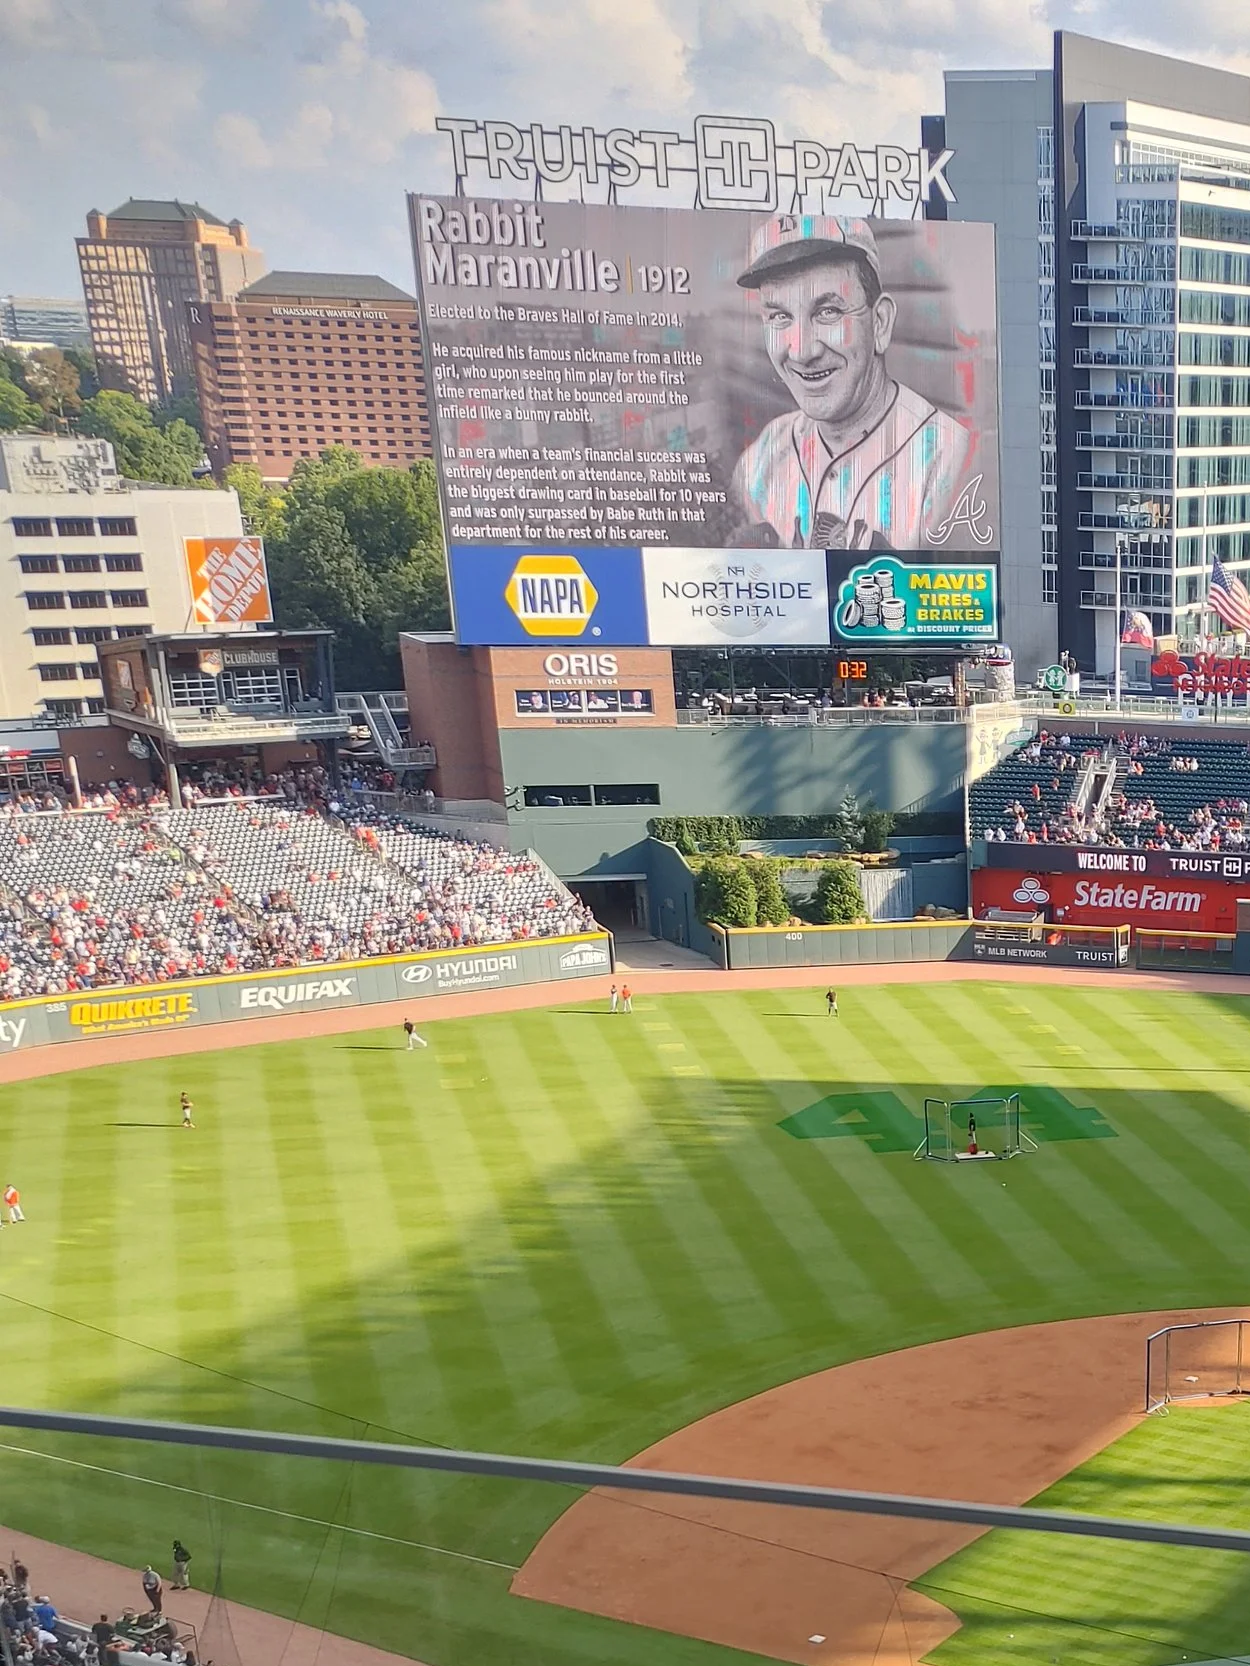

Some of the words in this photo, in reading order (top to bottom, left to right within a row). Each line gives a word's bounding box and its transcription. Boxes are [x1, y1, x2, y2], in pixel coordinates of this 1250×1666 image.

[436, 117, 680, 188] TRUIST
[794, 140, 958, 203] PARK
[422, 200, 546, 248] Rabbit
[425, 243, 620, 293] Maranville
[638, 265, 690, 294] 1912
[272, 307, 324, 316] RENAISSANCE
[326, 310, 361, 319] WAVERLY
[362, 311, 388, 320] HOTEL
[429, 304, 474, 320] Elected
[478, 308, 490, 320] to
[494, 307, 514, 321] the
[518, 308, 558, 323] Braves
[561, 309, 584, 324] Hall
[588, 310, 600, 324] of
[604, 311, 633, 326] Fame
[651, 312, 683, 328] 2014.
[432, 343, 449, 357] He
[452, 344, 504, 362] acquired
[507, 345, 524, 360] his
[528, 346, 570, 362] famous
[574, 348, 630, 364] nickname
[632, 350, 660, 364] from
[664, 354, 670, 364] a
[673, 351, 702, 366] little
[434, 364, 460, 381] girl,
[462, 365, 486, 379] who
[490, 368, 520, 384] upon
[523, 367, 562, 384] seeing
[565, 368, 586, 382] him
[589, 369, 614, 386] play
[616, 370, 634, 384] for
[637, 370, 656, 384] the
[660, 370, 685, 386] first
[444, 444, 456, 459] In
[459, 448, 473, 459] an
[477, 448, 496, 460] era
[499, 445, 529, 460] when
[532, 450, 540, 460] a
[542, 447, 581, 461] team's
[584, 448, 634, 462] financial
[637, 451, 681, 462] success
[684, 452, 706, 464] was
[196, 546, 228, 581] THE
[195, 538, 262, 622] HOME
[910, 573, 987, 590] MAVIS
[225, 568, 266, 621] DEPOT
[520, 577, 585, 614] NAPA
[662, 582, 813, 599] NORTHSIDE
[919, 593, 972, 606] TIRES
[692, 605, 786, 617] HOSPITAL
[917, 609, 984, 622] BRAKES
[917, 625, 960, 633] DISCOUNT
[223, 651, 277, 665] CLUBHOUSE
[545, 653, 618, 676] ORIS
[840, 662, 867, 679] 0:32
[1078, 852, 1129, 871] WELCOME
[1132, 855, 1147, 872] TO
[1169, 858, 1221, 873] TRUIST
[785, 933, 803, 941] 400
[562, 953, 580, 967] PAPA
[988, 947, 1005, 956] MLB
[1007, 949, 1047, 958] NETWORK
[1076, 951, 1114, 962] TRUIST
[436, 956, 517, 978] HYUNDAI
[438, 974, 500, 989] BuyHyundai.com
[239, 978, 353, 1010] EQUIFAX
[70, 993, 193, 1026] QUIKRETE
